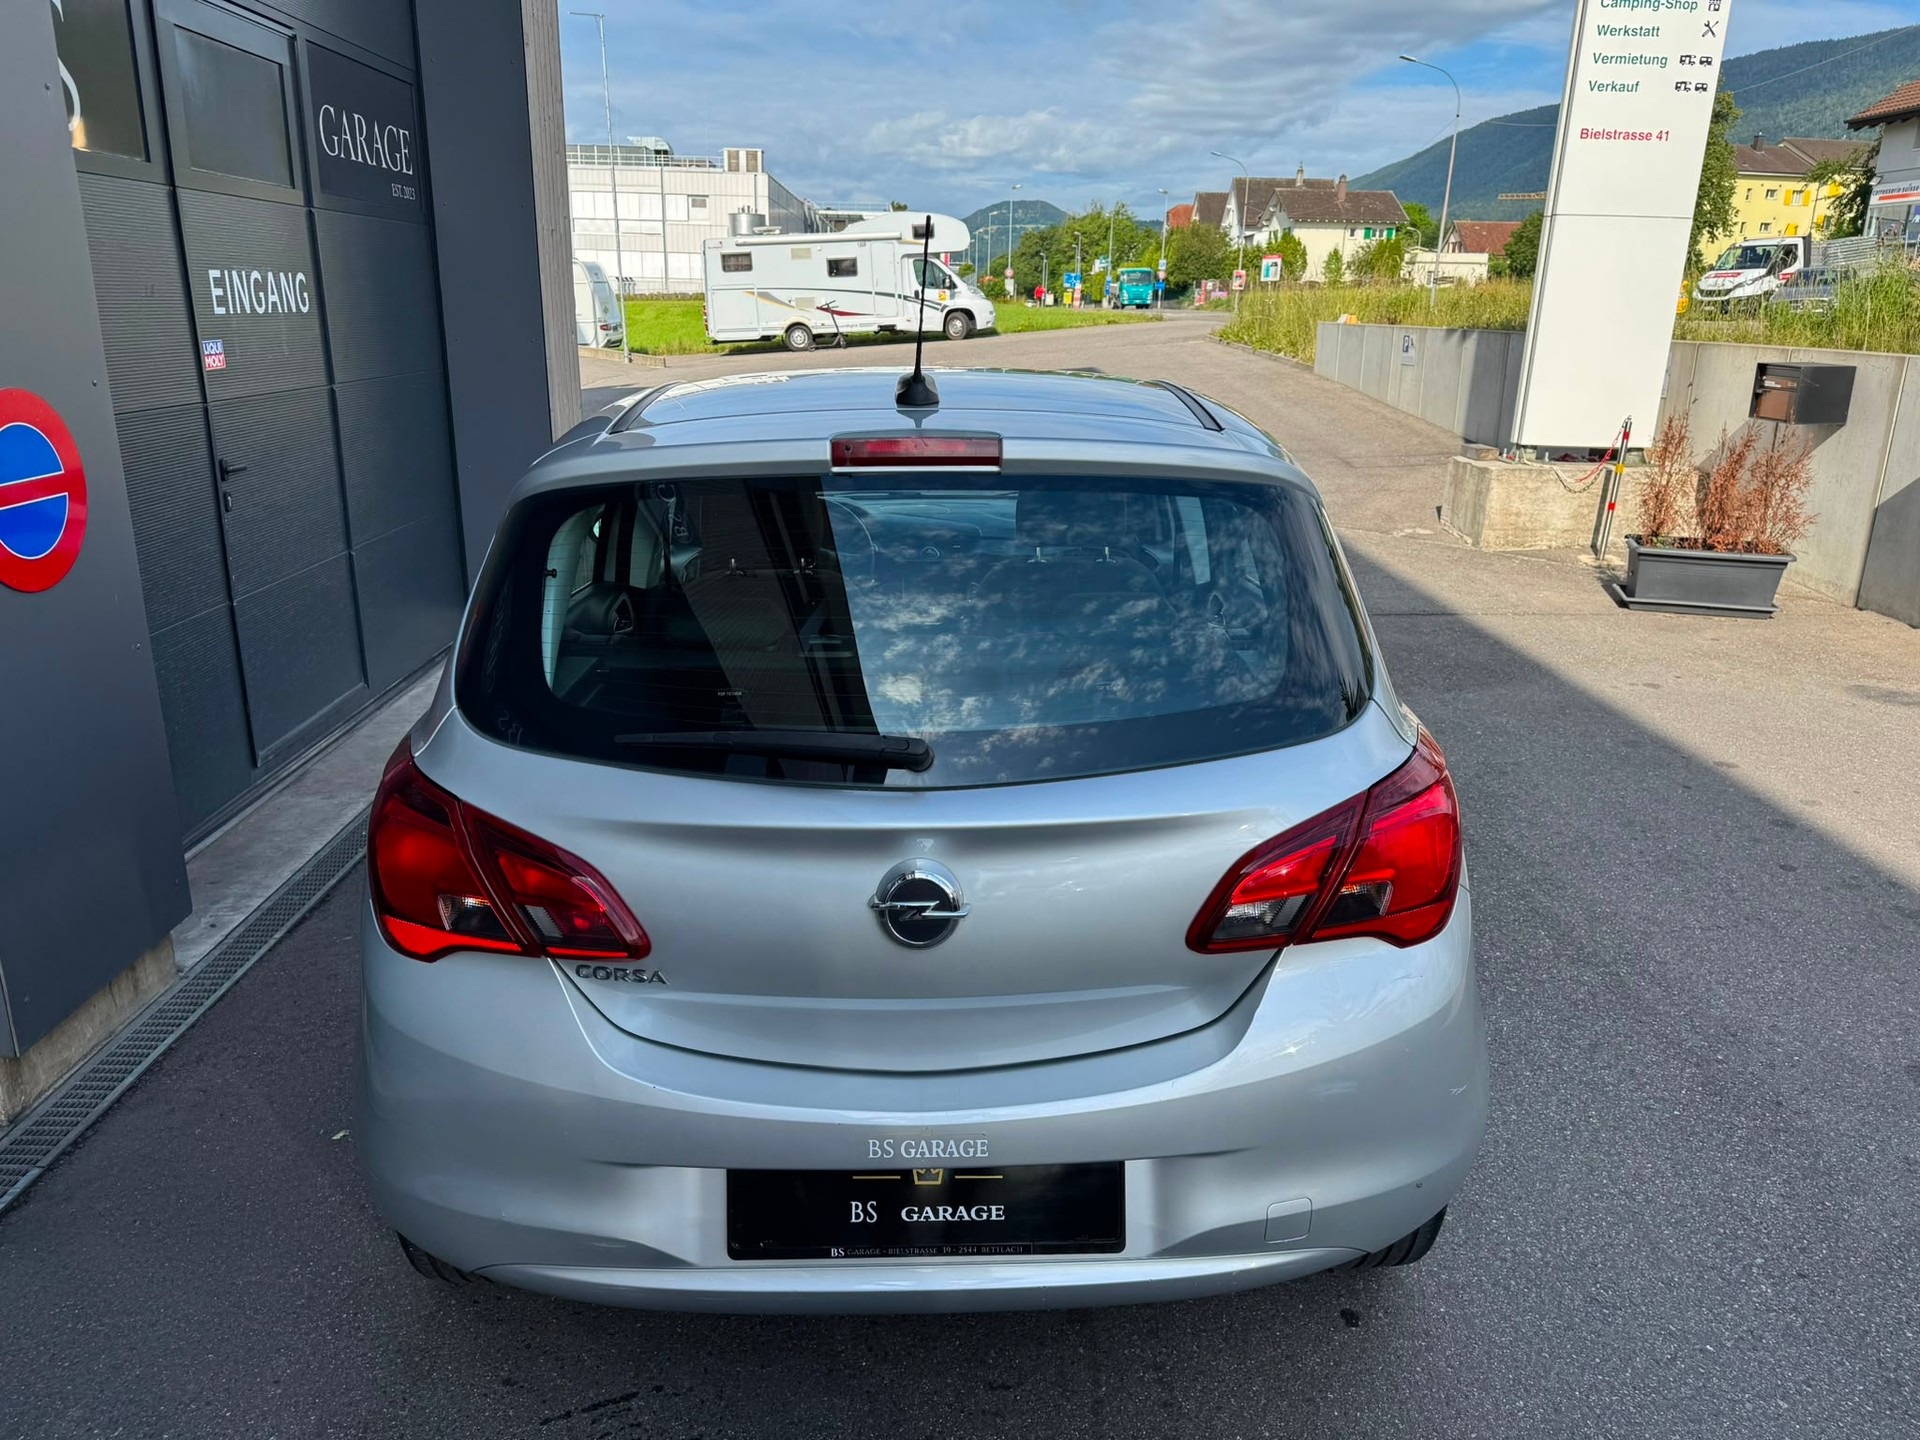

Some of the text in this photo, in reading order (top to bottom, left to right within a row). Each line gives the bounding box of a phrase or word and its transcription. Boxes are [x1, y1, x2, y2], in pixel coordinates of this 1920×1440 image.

[1600, 0, 1698, 13] Camping-Shop
[1597, 24, 1661, 38] Werkstatt
[1593, 52, 1668, 69] Vermietung
[1589, 80, 1640, 93] Verkauf
[319, 104, 413, 175] GARAGE
[1580, 128, 1670, 142] Bielstrasse 41
[208, 269, 310, 315] EINGANG
[205, 354, 226, 368] MOLY
[575, 964, 670, 985] CORSA
[868, 1139, 989, 1159] BS GARAGE
[850, 1201, 1005, 1223] BS GARAGE
[831, 1247, 845, 1257] BS
[847, 1248, 880, 1256] GARAGE
